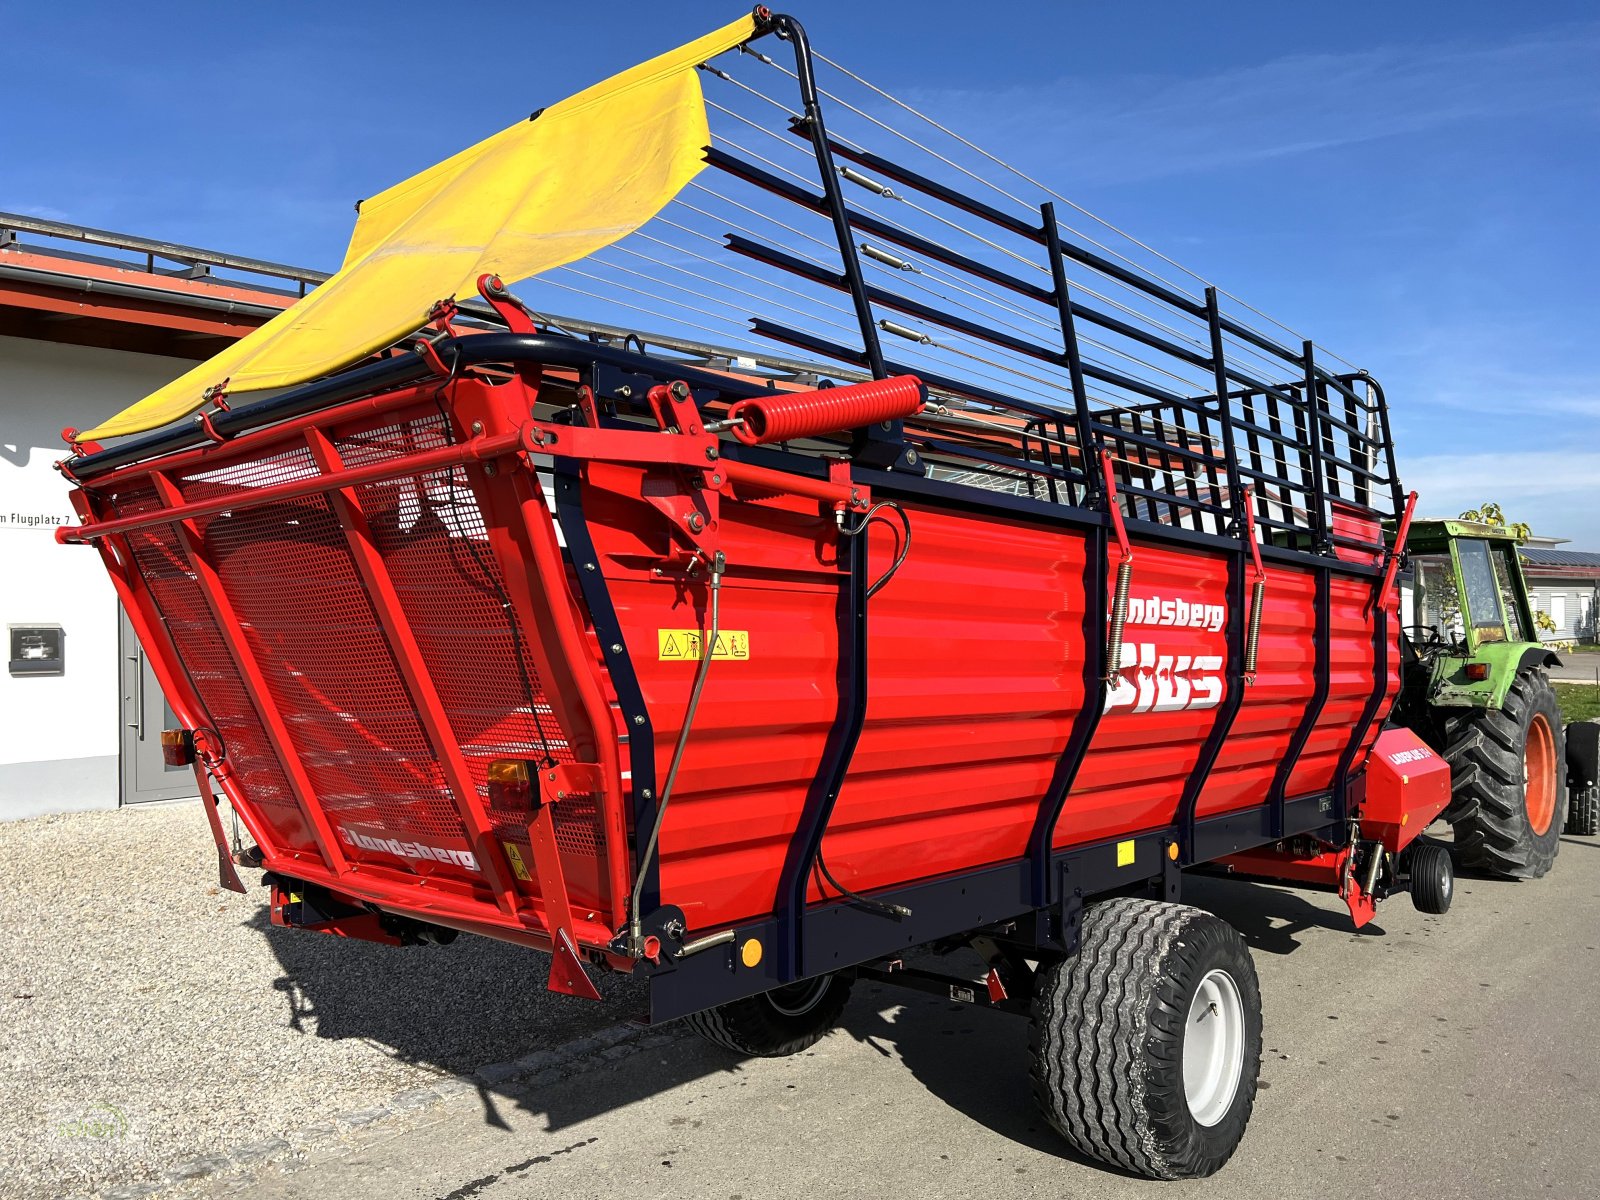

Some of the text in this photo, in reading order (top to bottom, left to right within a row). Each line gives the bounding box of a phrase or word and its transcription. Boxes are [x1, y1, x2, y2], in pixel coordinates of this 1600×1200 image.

[11, 513, 61, 526] Flugplatz
[65, 516, 70, 525] 7
[1107, 596, 1225, 632] ndsberg
